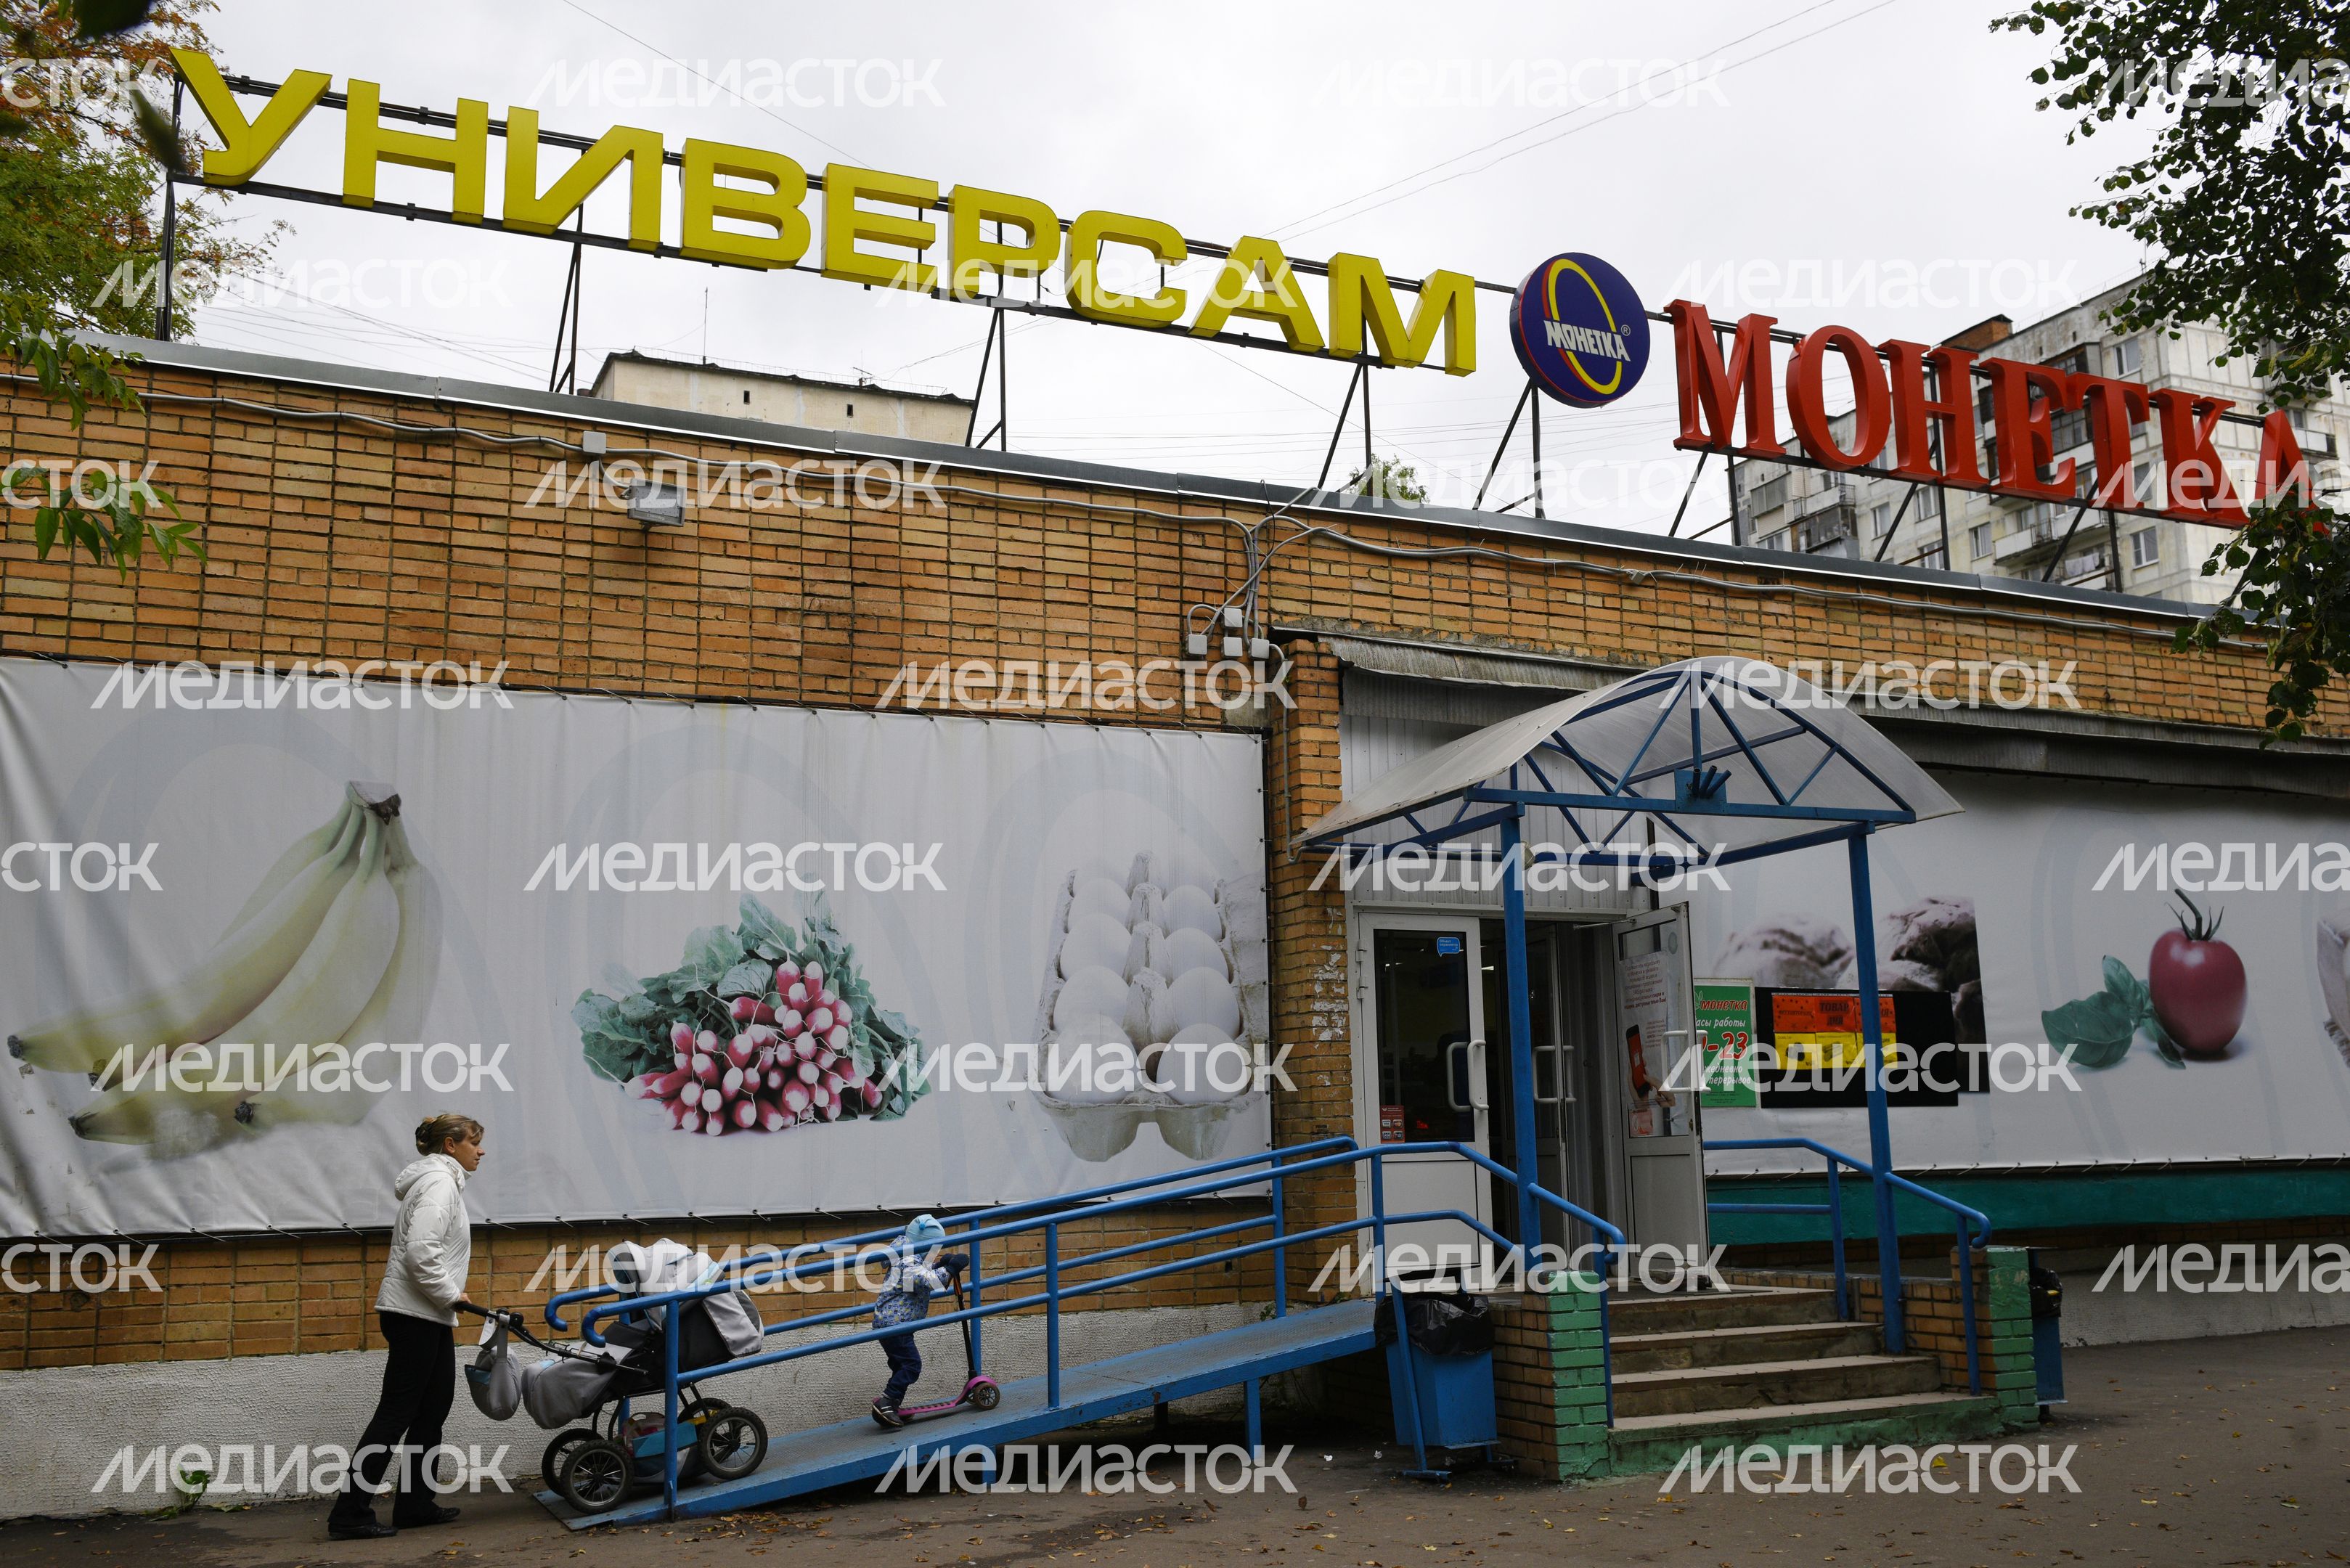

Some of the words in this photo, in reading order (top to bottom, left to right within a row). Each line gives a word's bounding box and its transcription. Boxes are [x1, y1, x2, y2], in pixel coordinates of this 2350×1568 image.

[169, 47, 1477, 377] УНИВЕРСАМ
[1543, 319, 1631, 362] МОНЕТКА
[1664, 298, 2329, 536] МОНЕТКА
[1701, 1000, 1748, 1011] монетка
[1819, 1001, 1850, 1013] ТОВАР
[1695, 1018, 1712, 1027] асы
[1713, 1016, 1746, 1029] работы
[1705, 1063, 1743, 1073] жедневно
